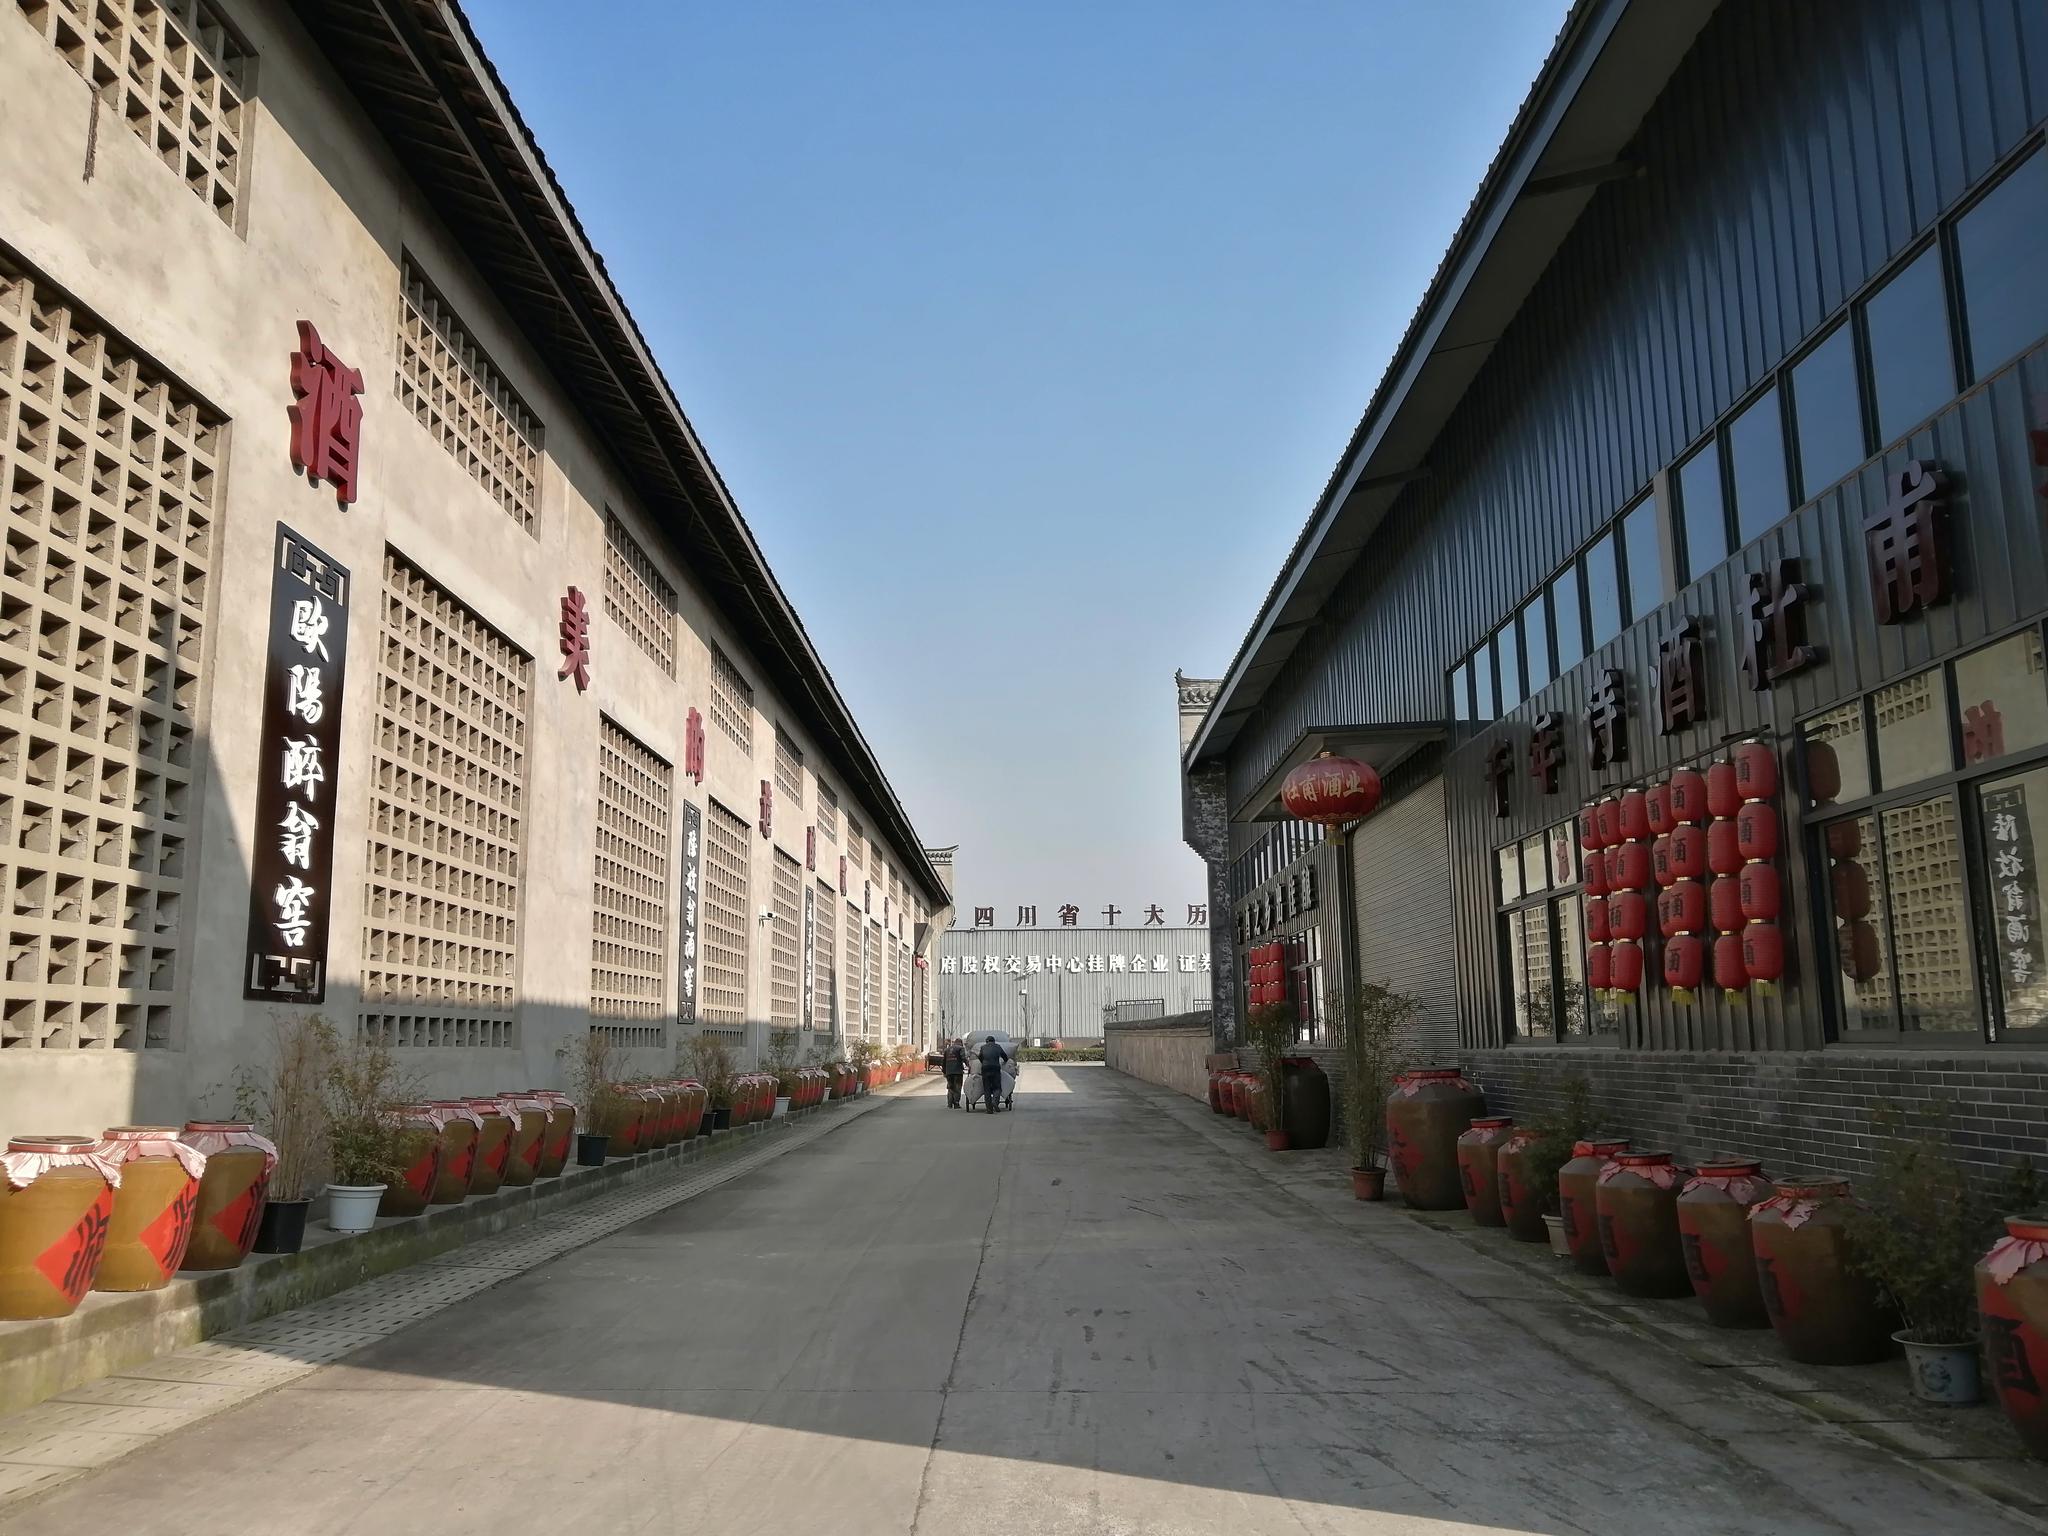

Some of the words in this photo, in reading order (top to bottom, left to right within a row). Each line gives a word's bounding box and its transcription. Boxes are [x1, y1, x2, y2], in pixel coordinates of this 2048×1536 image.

[287, 320, 365, 512] 酒
[947, 903, 1208, 928] 四川省十大历
[940, 954, 1169, 974] 府股权交易中心挂牌企业
